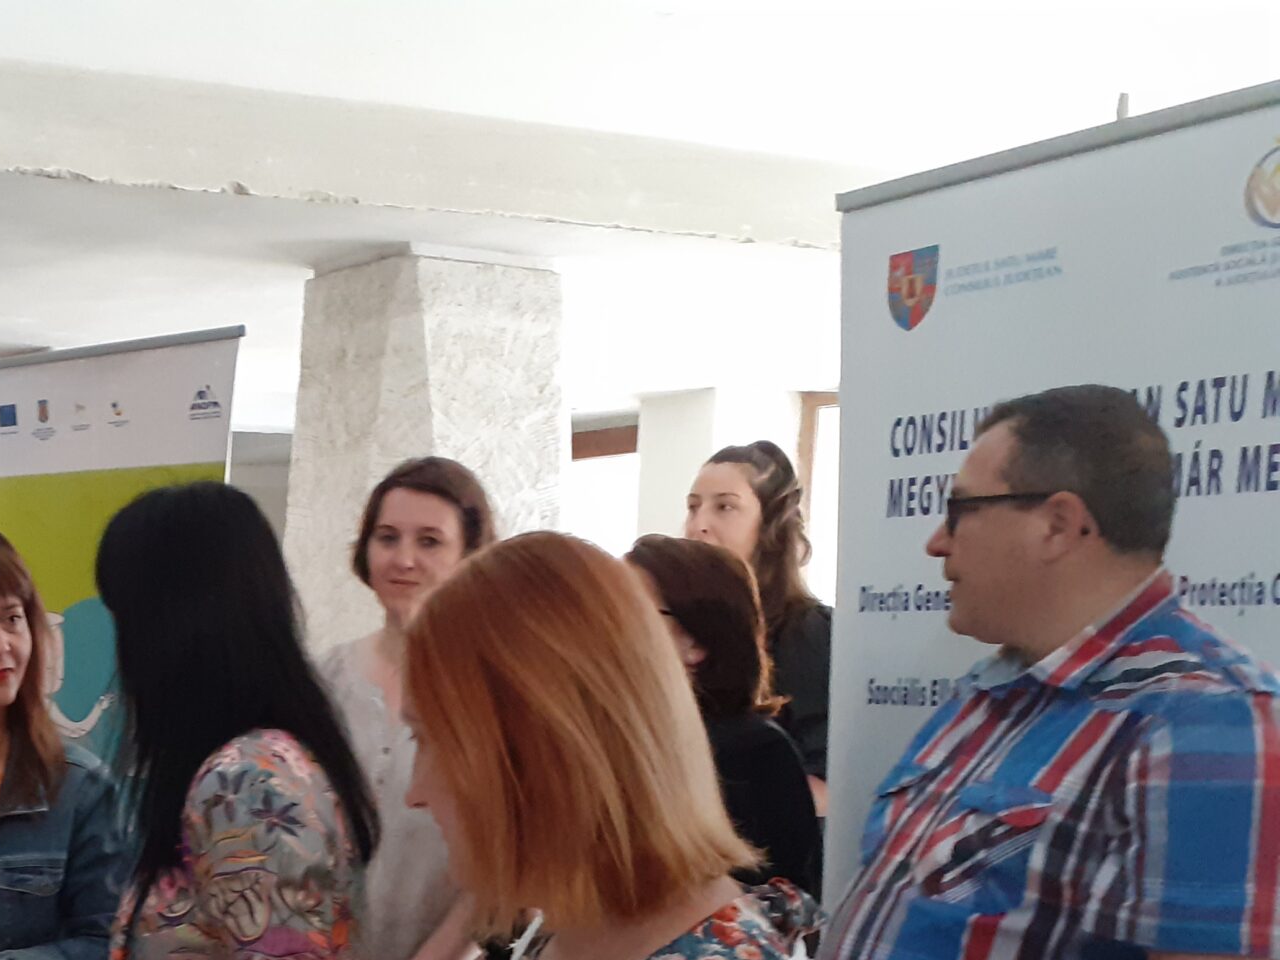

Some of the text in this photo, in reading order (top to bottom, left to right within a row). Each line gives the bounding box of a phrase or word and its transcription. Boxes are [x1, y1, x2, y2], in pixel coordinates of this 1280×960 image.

[890, 406, 990, 458] CONSILI
[1174, 374, 1249, 428] SATU
[886, 472, 959, 518] MEGY
[1237, 443, 1280, 493] ME
[914, 583, 951, 611] Gene
